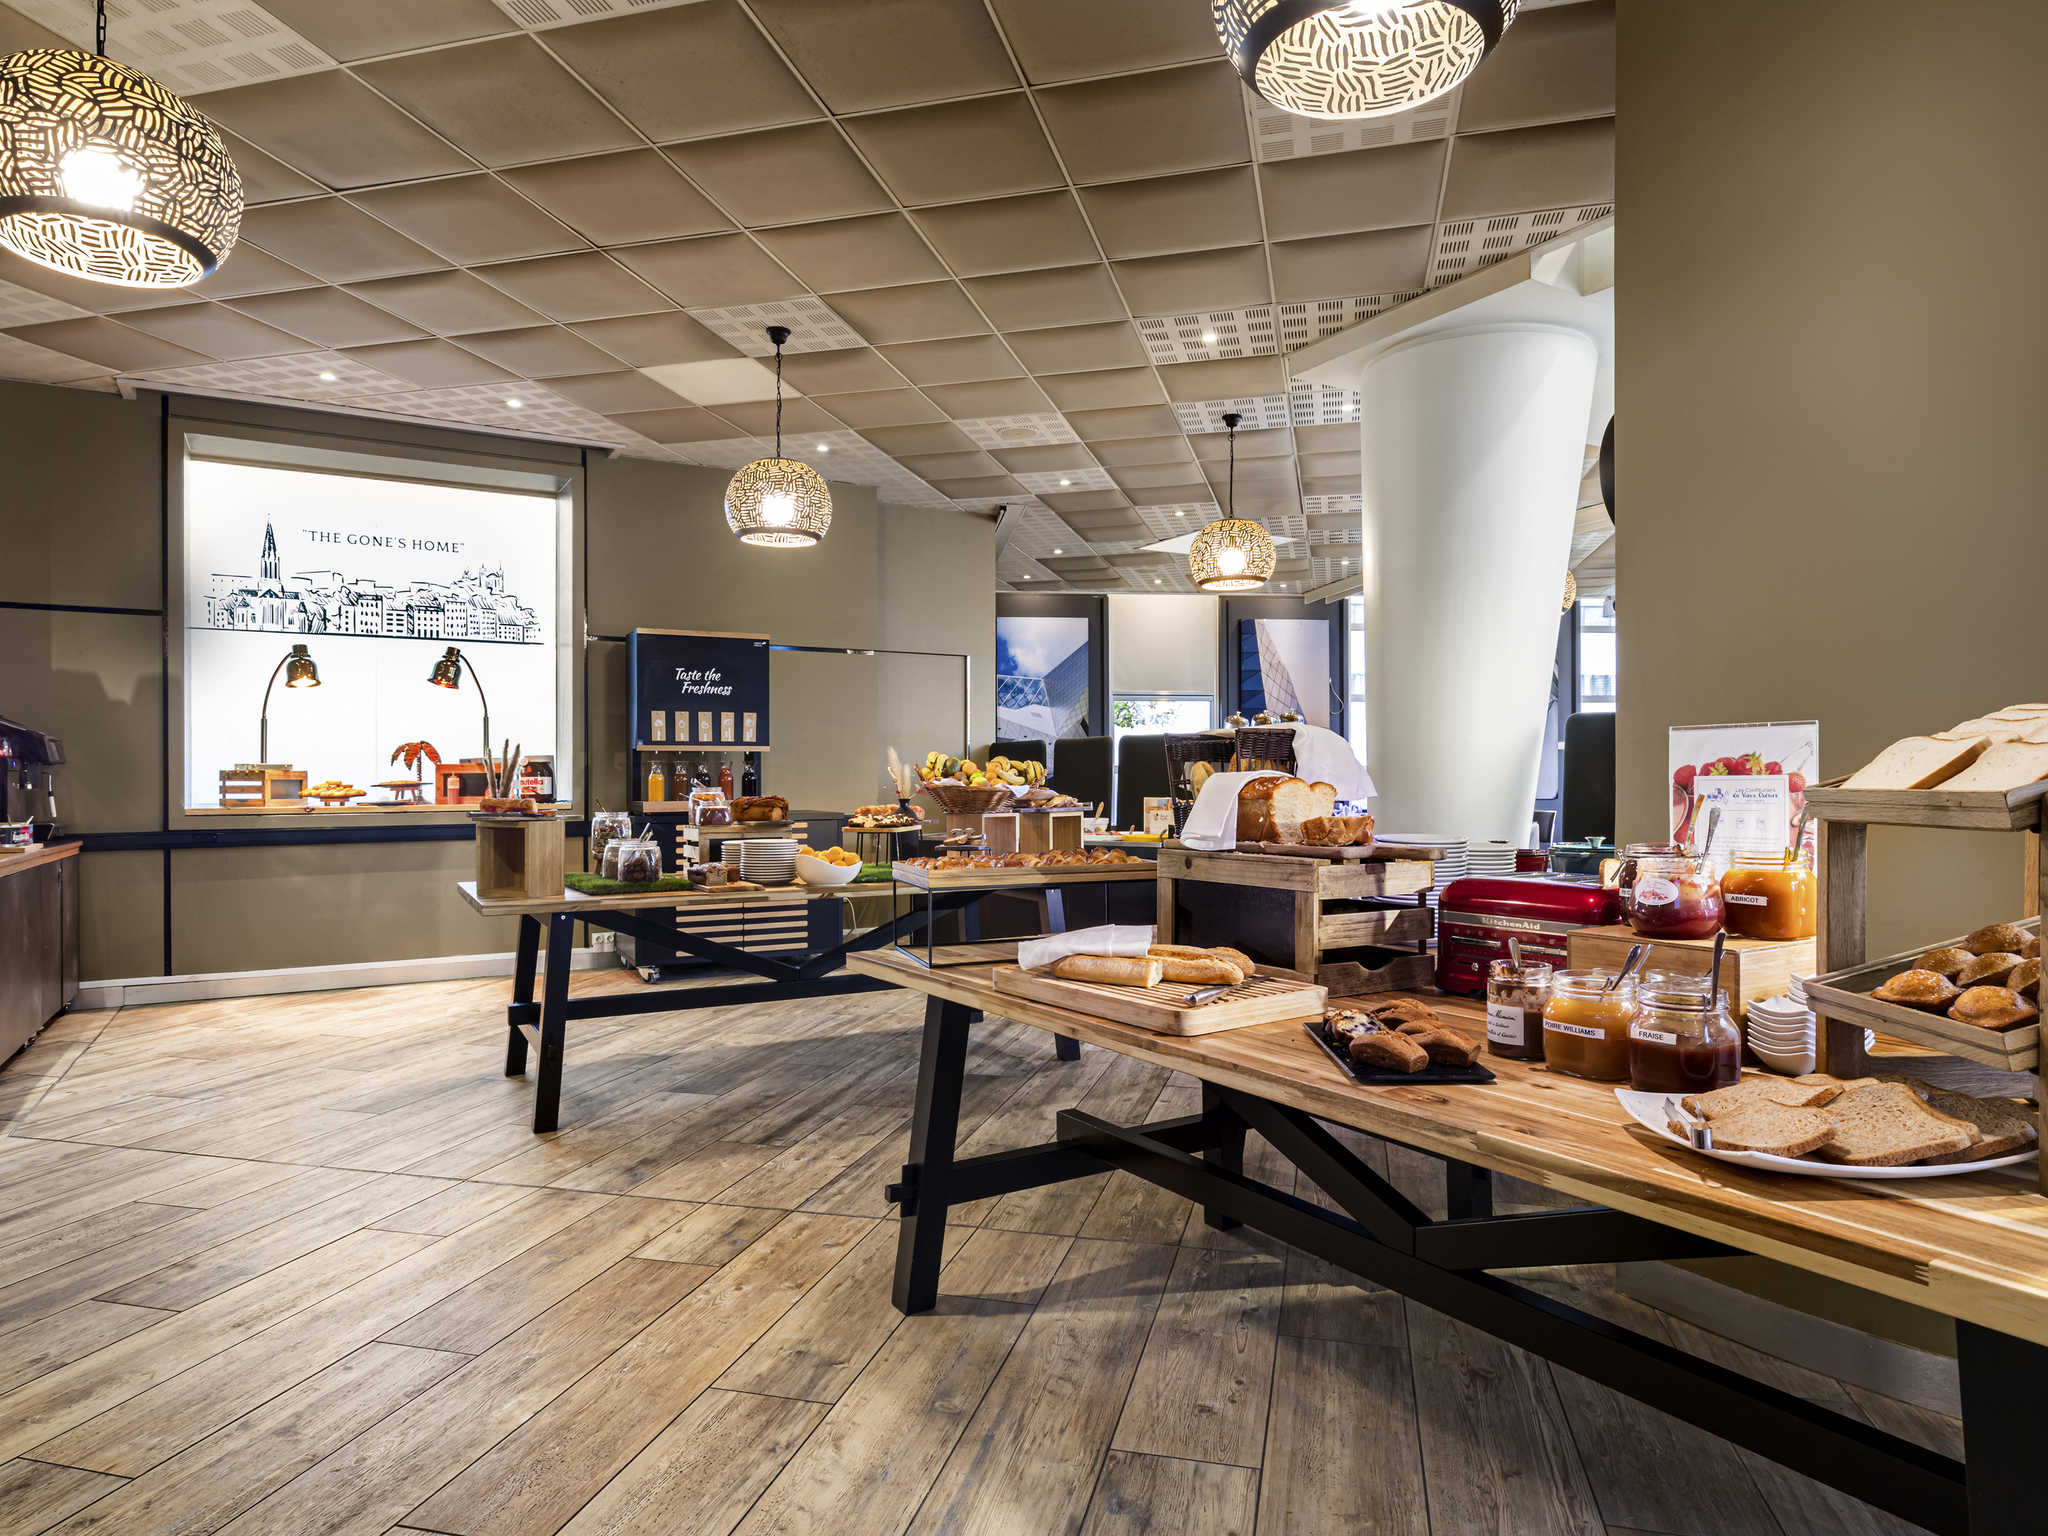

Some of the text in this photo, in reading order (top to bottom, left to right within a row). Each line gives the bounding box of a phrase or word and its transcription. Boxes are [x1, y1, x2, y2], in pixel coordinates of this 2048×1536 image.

[302, 528, 465, 553] "THE GONE'S HOME"
[675, 667, 721, 682] Taste the
[681, 681, 733, 696] Freshness
[1730, 895, 1759, 904] ABRICOT
[1481, 917, 1541, 930] KitchenAid
[1563, 1025, 1596, 1037] WILLIAMS
[1638, 1030, 1664, 1041] FRAISE
